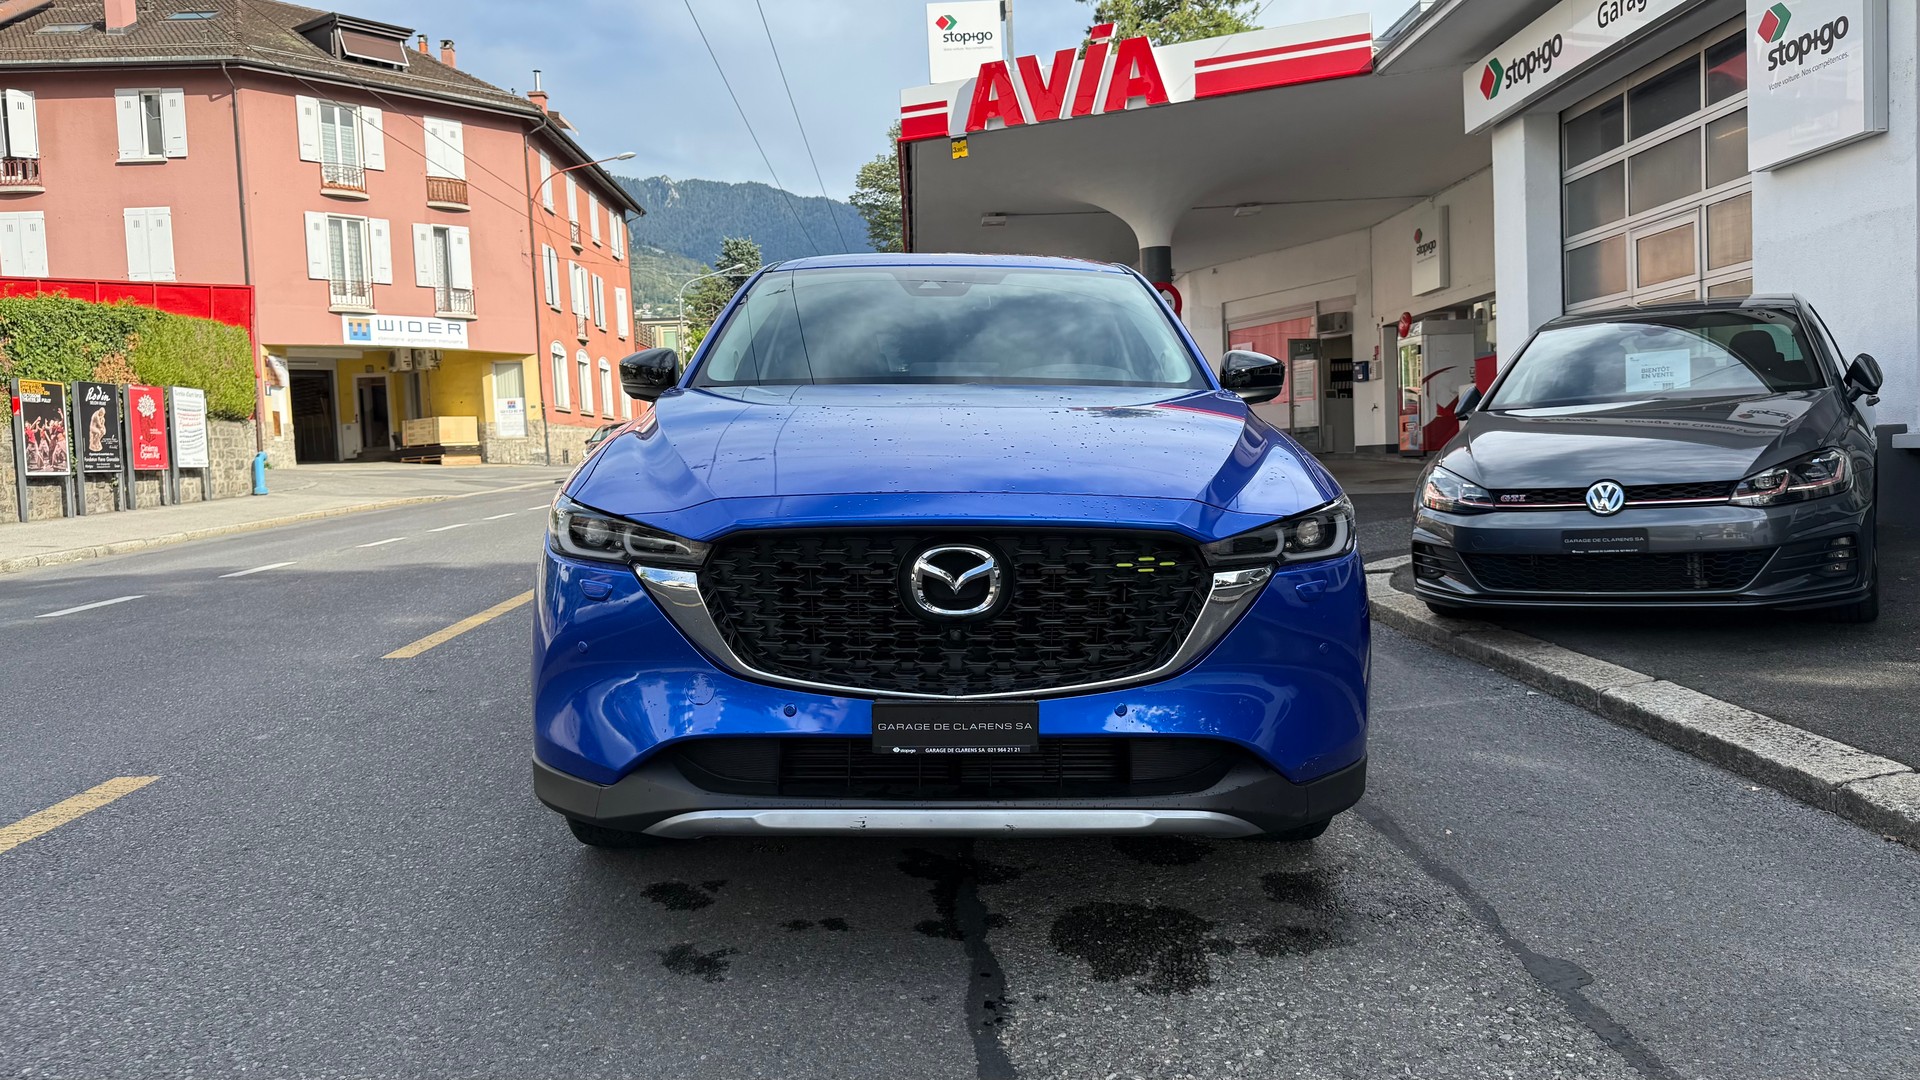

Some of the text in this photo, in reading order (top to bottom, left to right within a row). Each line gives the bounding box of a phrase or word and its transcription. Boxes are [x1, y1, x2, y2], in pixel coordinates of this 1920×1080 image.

[943, 32, 993, 45] stop+go
[1768, 16, 1849, 72] stop+go
[1505, 33, 1563, 90] stop+go
[377, 319, 462, 335] WIDER
[1500, 494, 1526, 502] GTI
[1015, 722, 1033, 730] SA
